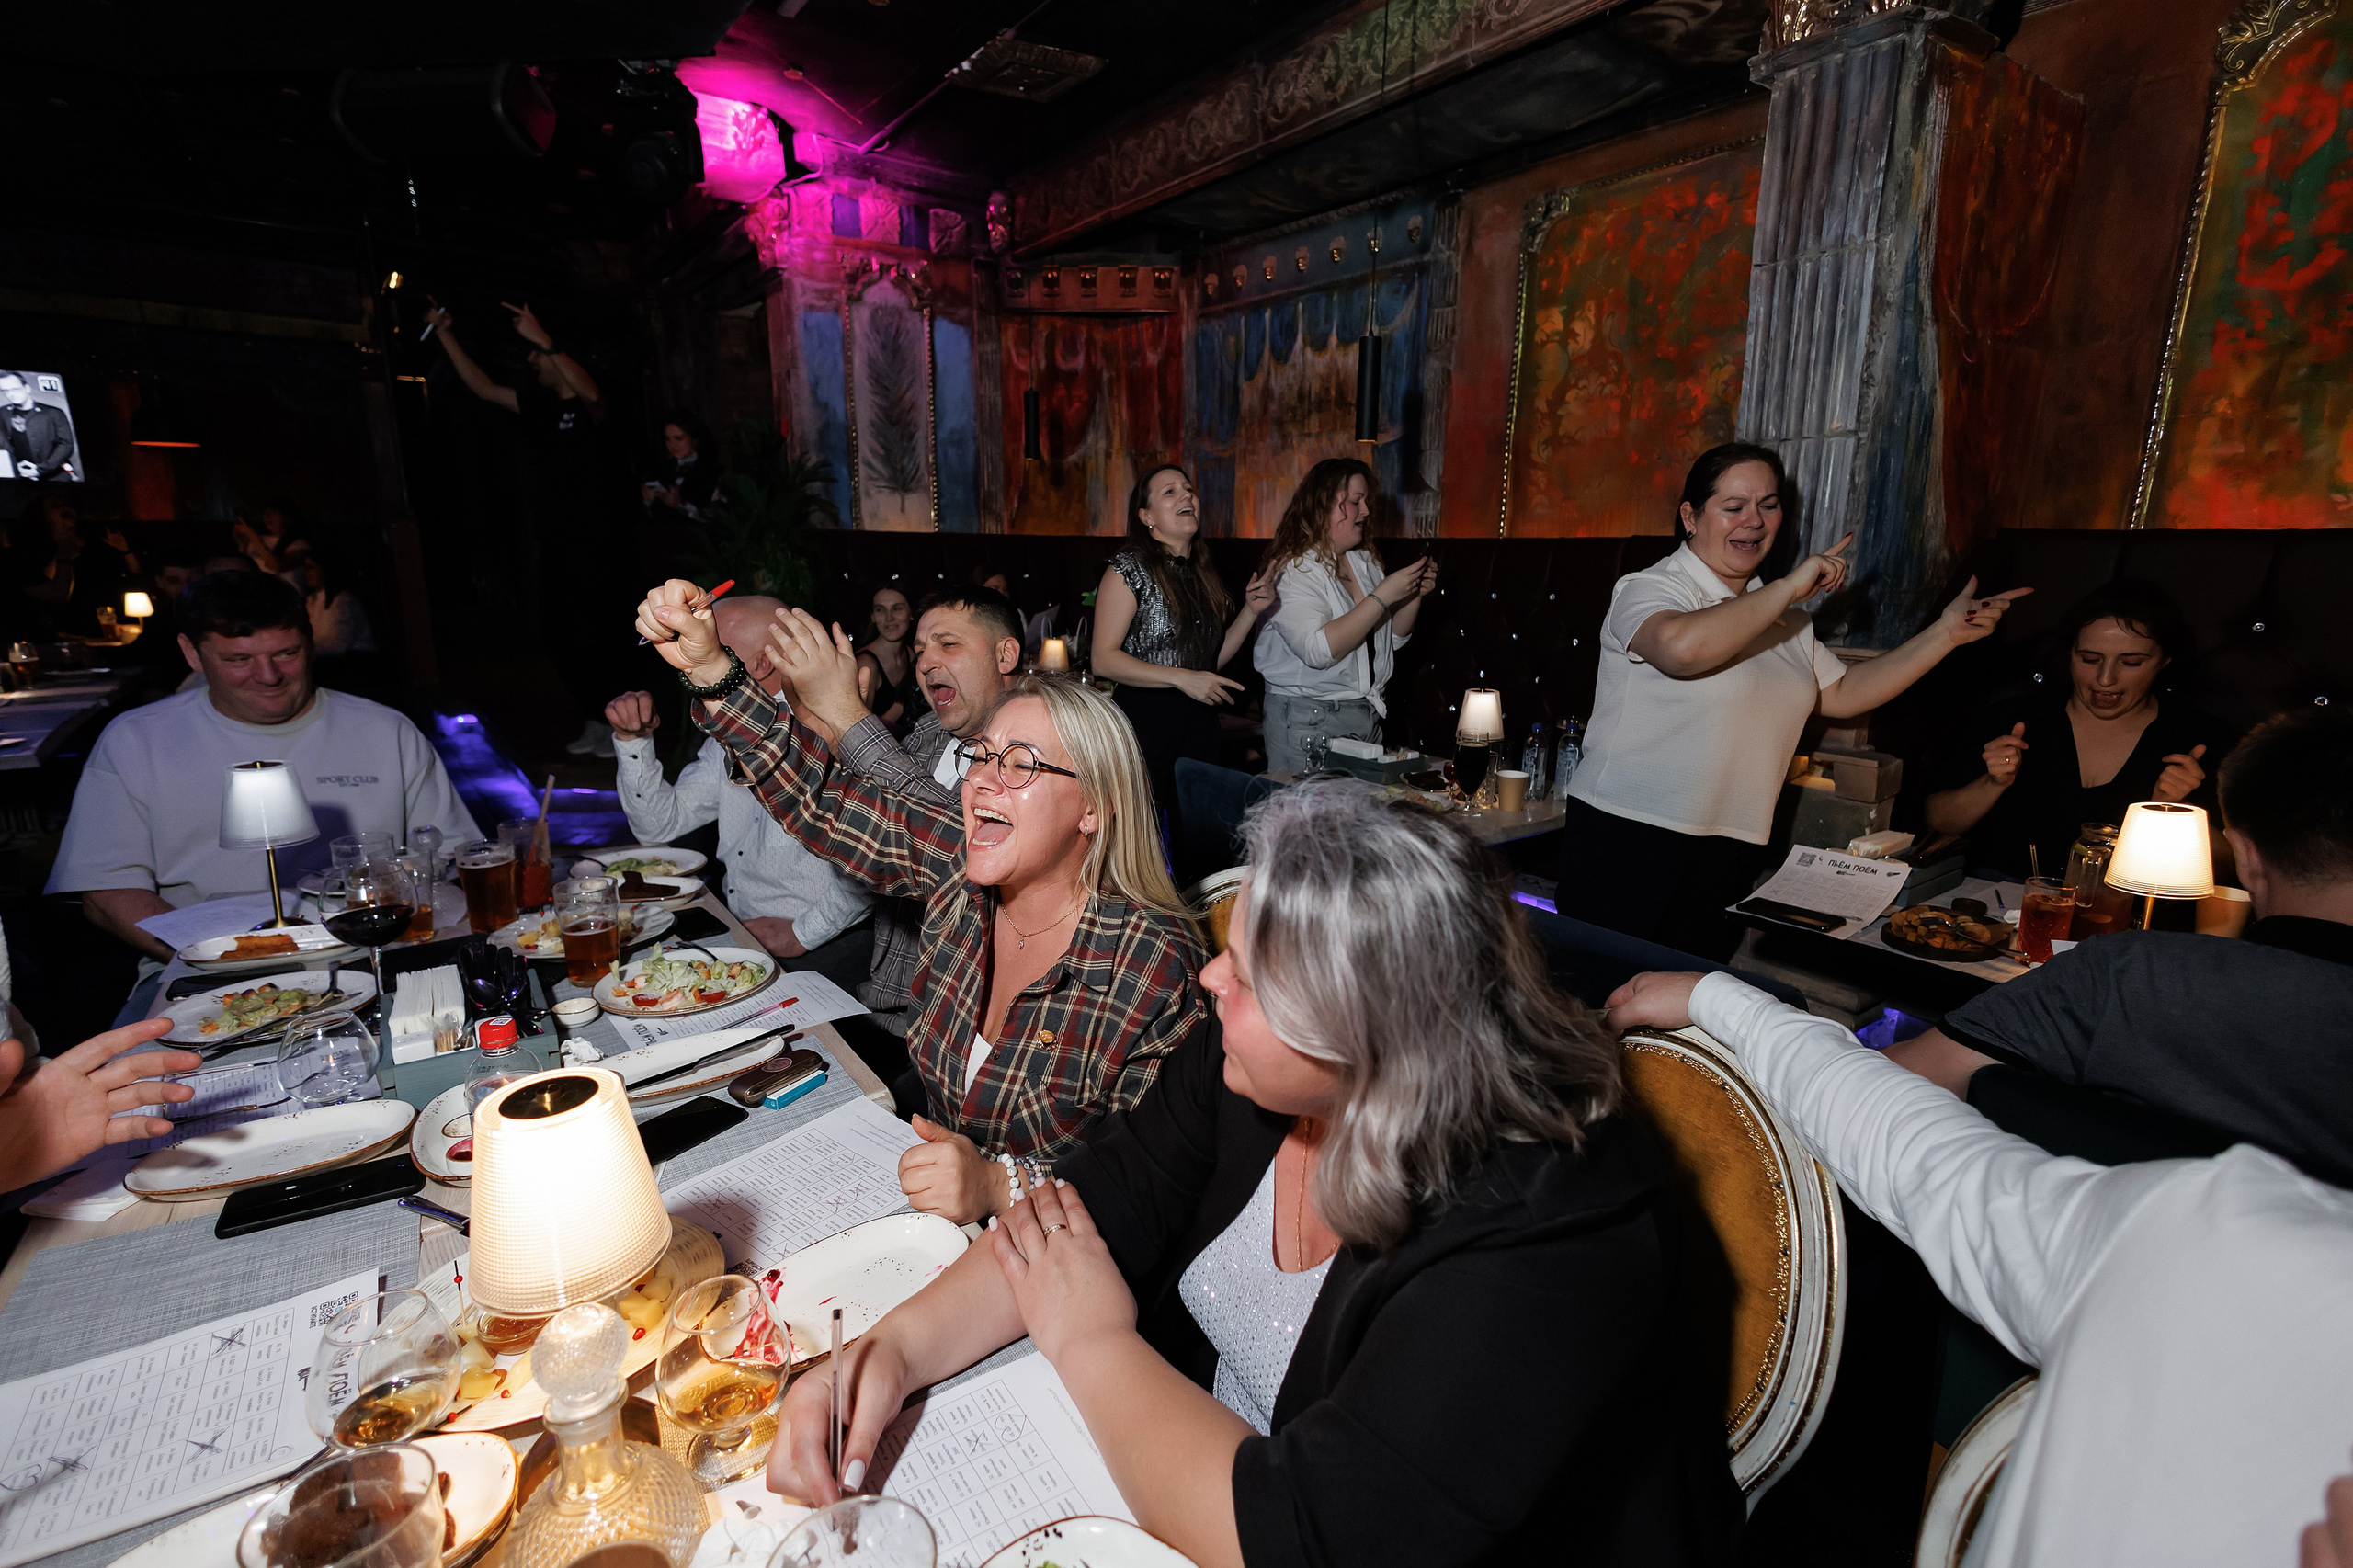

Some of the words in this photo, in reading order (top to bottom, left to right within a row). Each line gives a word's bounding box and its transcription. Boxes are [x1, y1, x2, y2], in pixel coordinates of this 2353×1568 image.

[1828, 859, 1850, 869] ПЬЁМ
[1852, 864, 1878, 875] ПОЁМ
[328, 1372, 353, 1407] ПОЁМ
